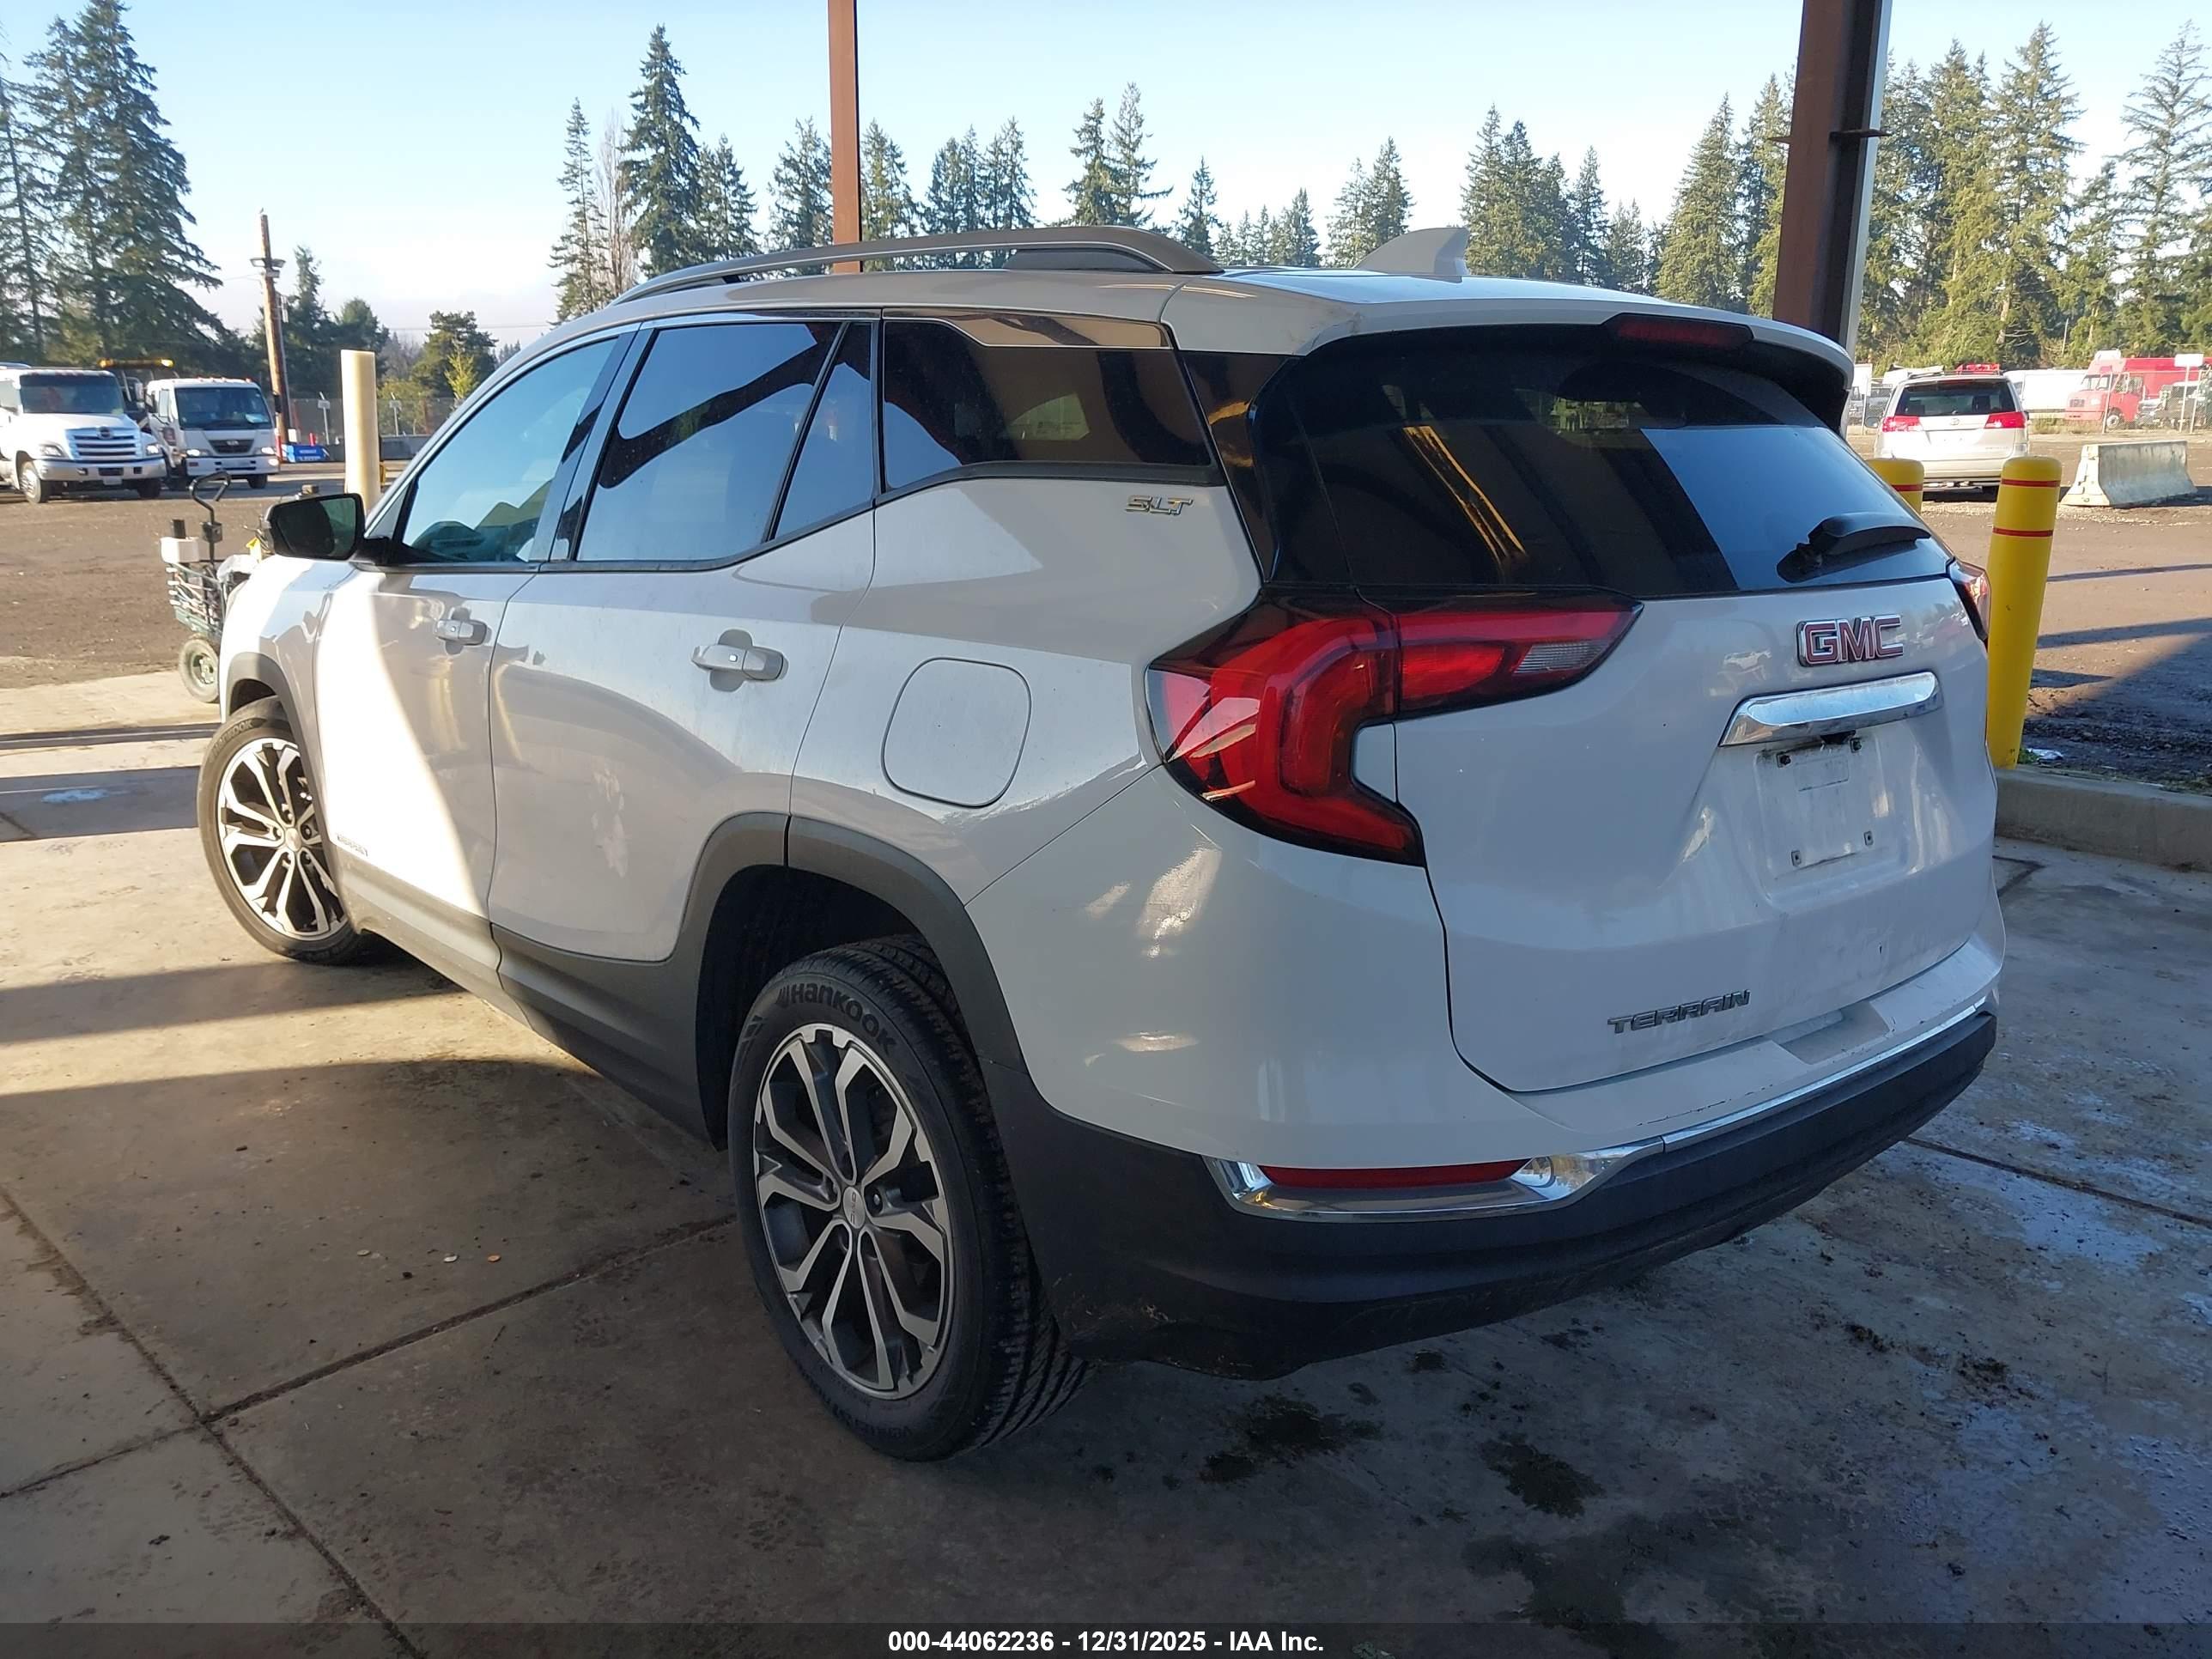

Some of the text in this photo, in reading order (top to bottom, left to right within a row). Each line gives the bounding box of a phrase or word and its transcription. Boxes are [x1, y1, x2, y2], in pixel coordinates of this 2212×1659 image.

[1126, 495, 1194, 516] SLT
[1796, 614, 1904, 666] GMC
[1607, 989, 1751, 1034] TERRAIN
